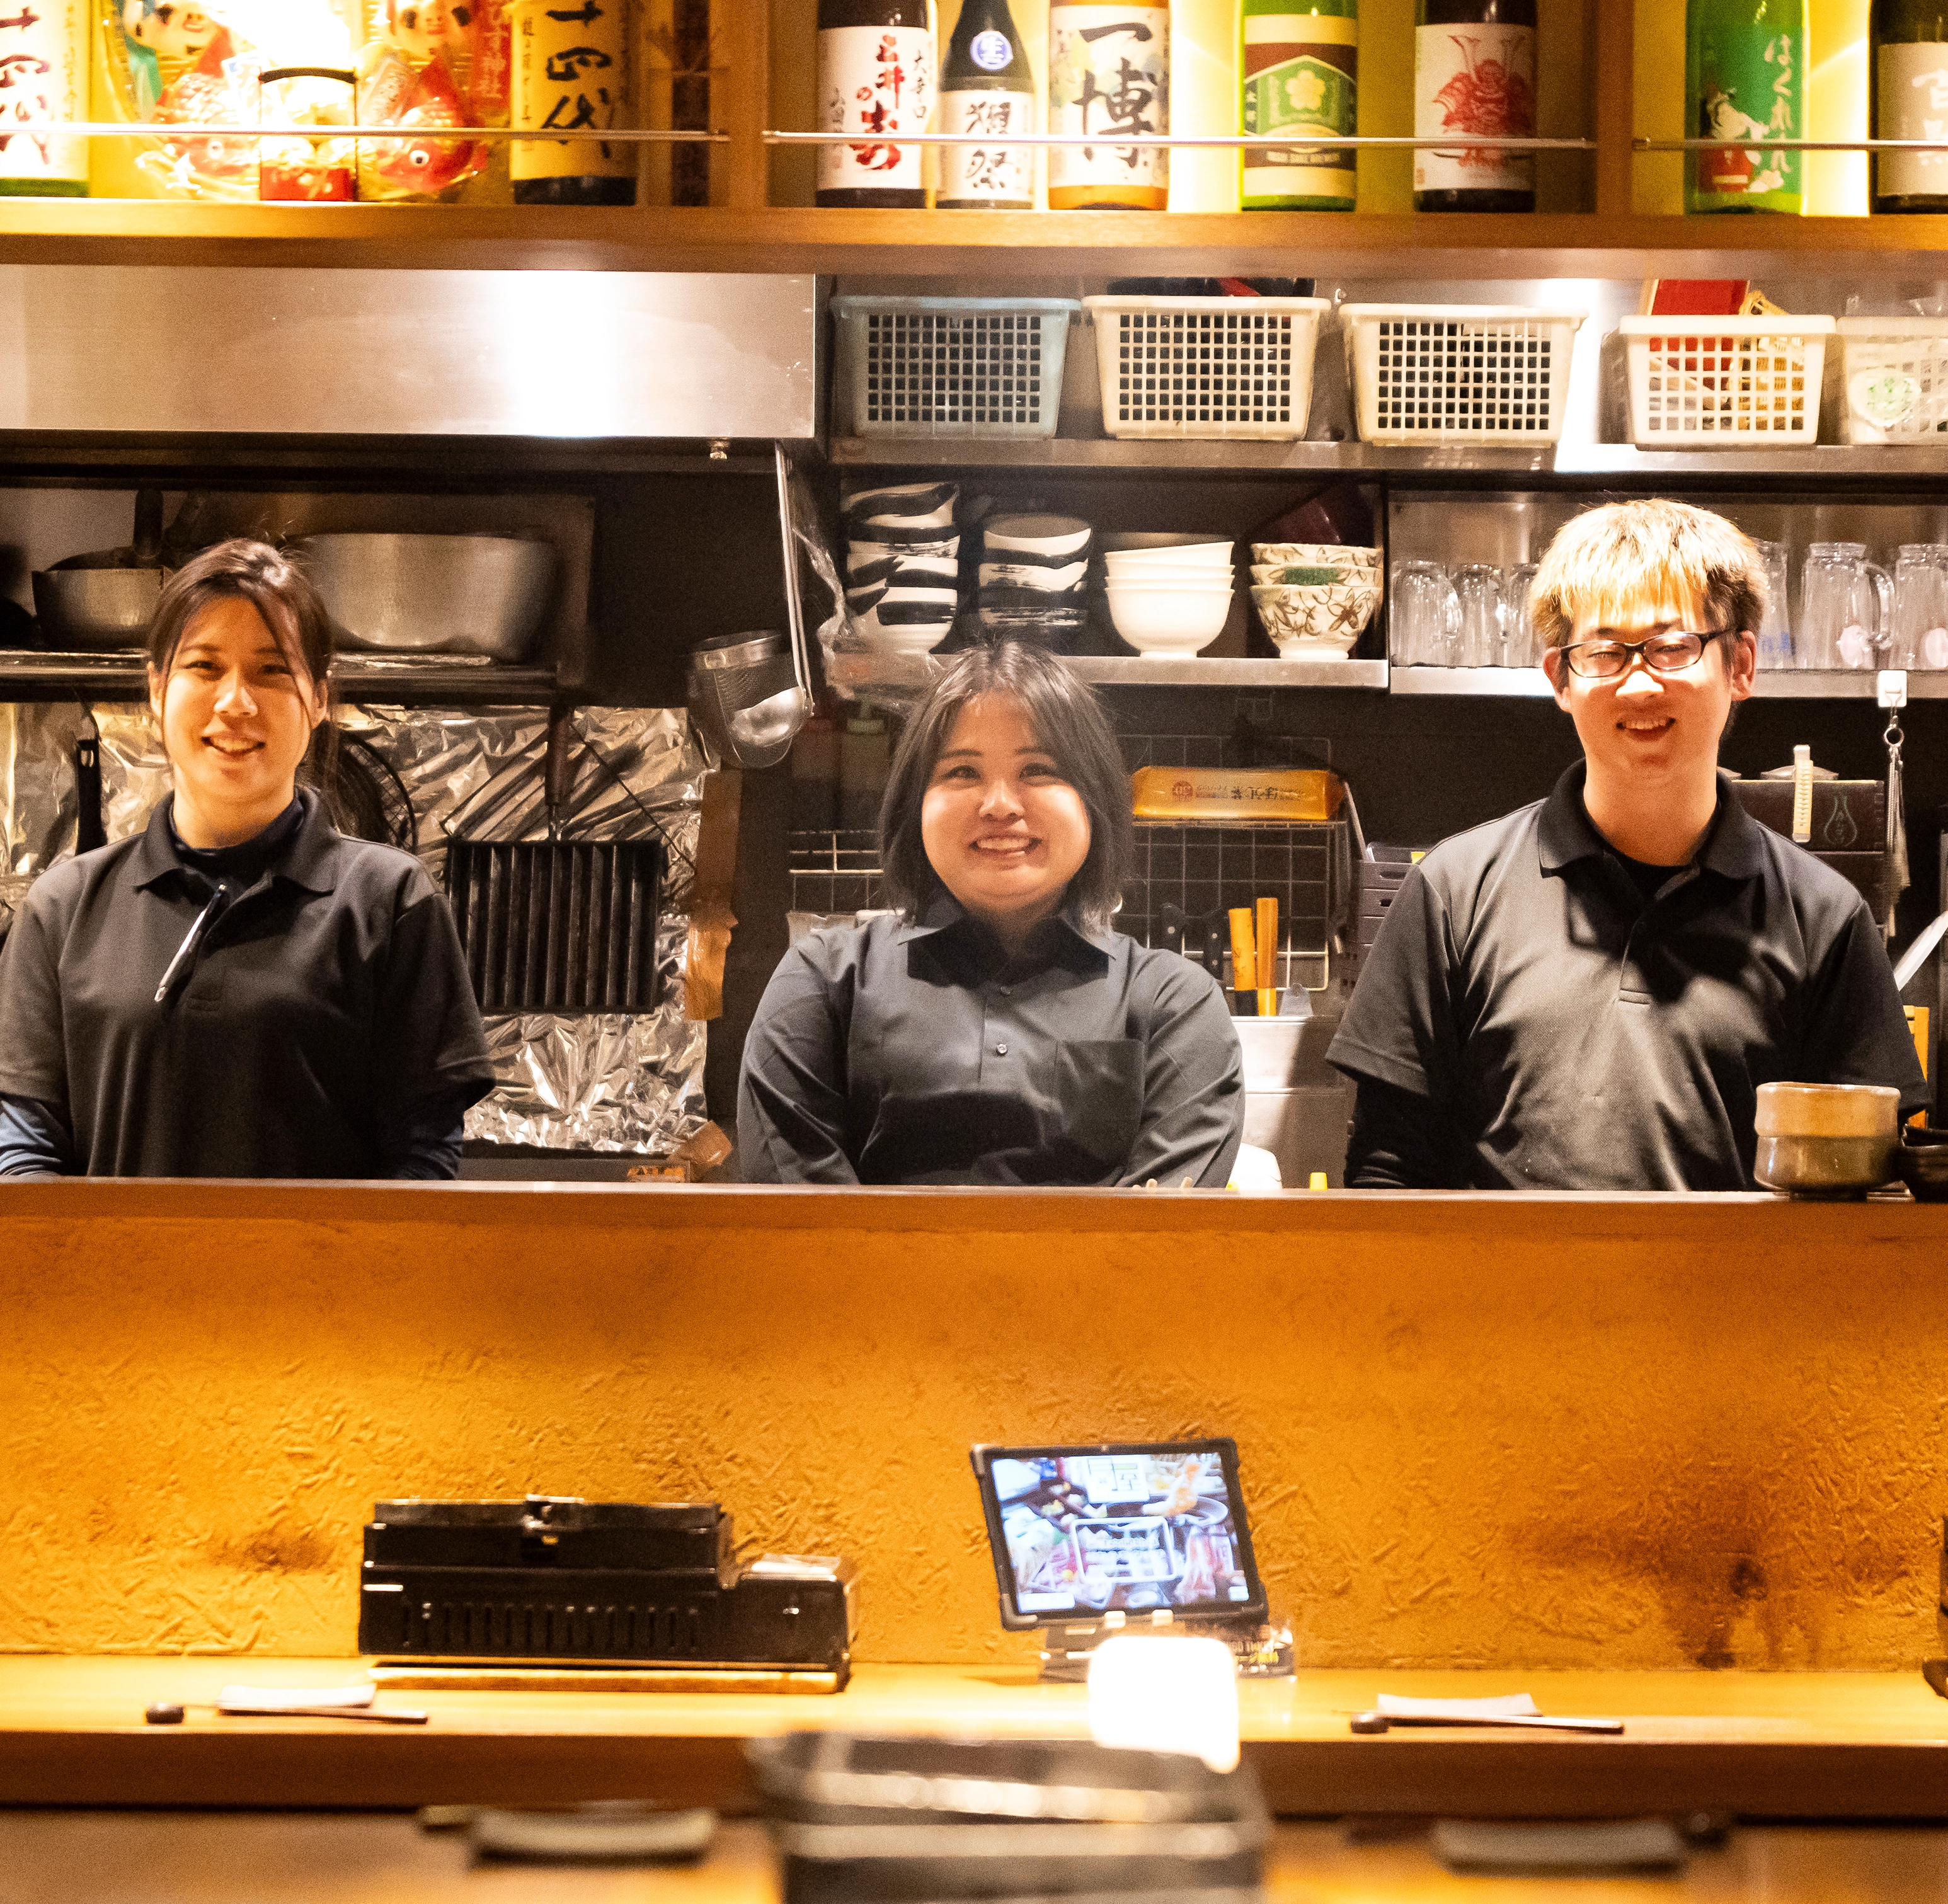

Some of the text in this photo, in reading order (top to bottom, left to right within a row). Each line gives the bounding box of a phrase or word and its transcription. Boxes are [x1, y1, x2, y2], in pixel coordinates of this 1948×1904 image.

[542, 0, 612, 159] 十四代
[965, 101, 1014, 190] 獺祭
[1072, 22, 1158, 169] 一博
